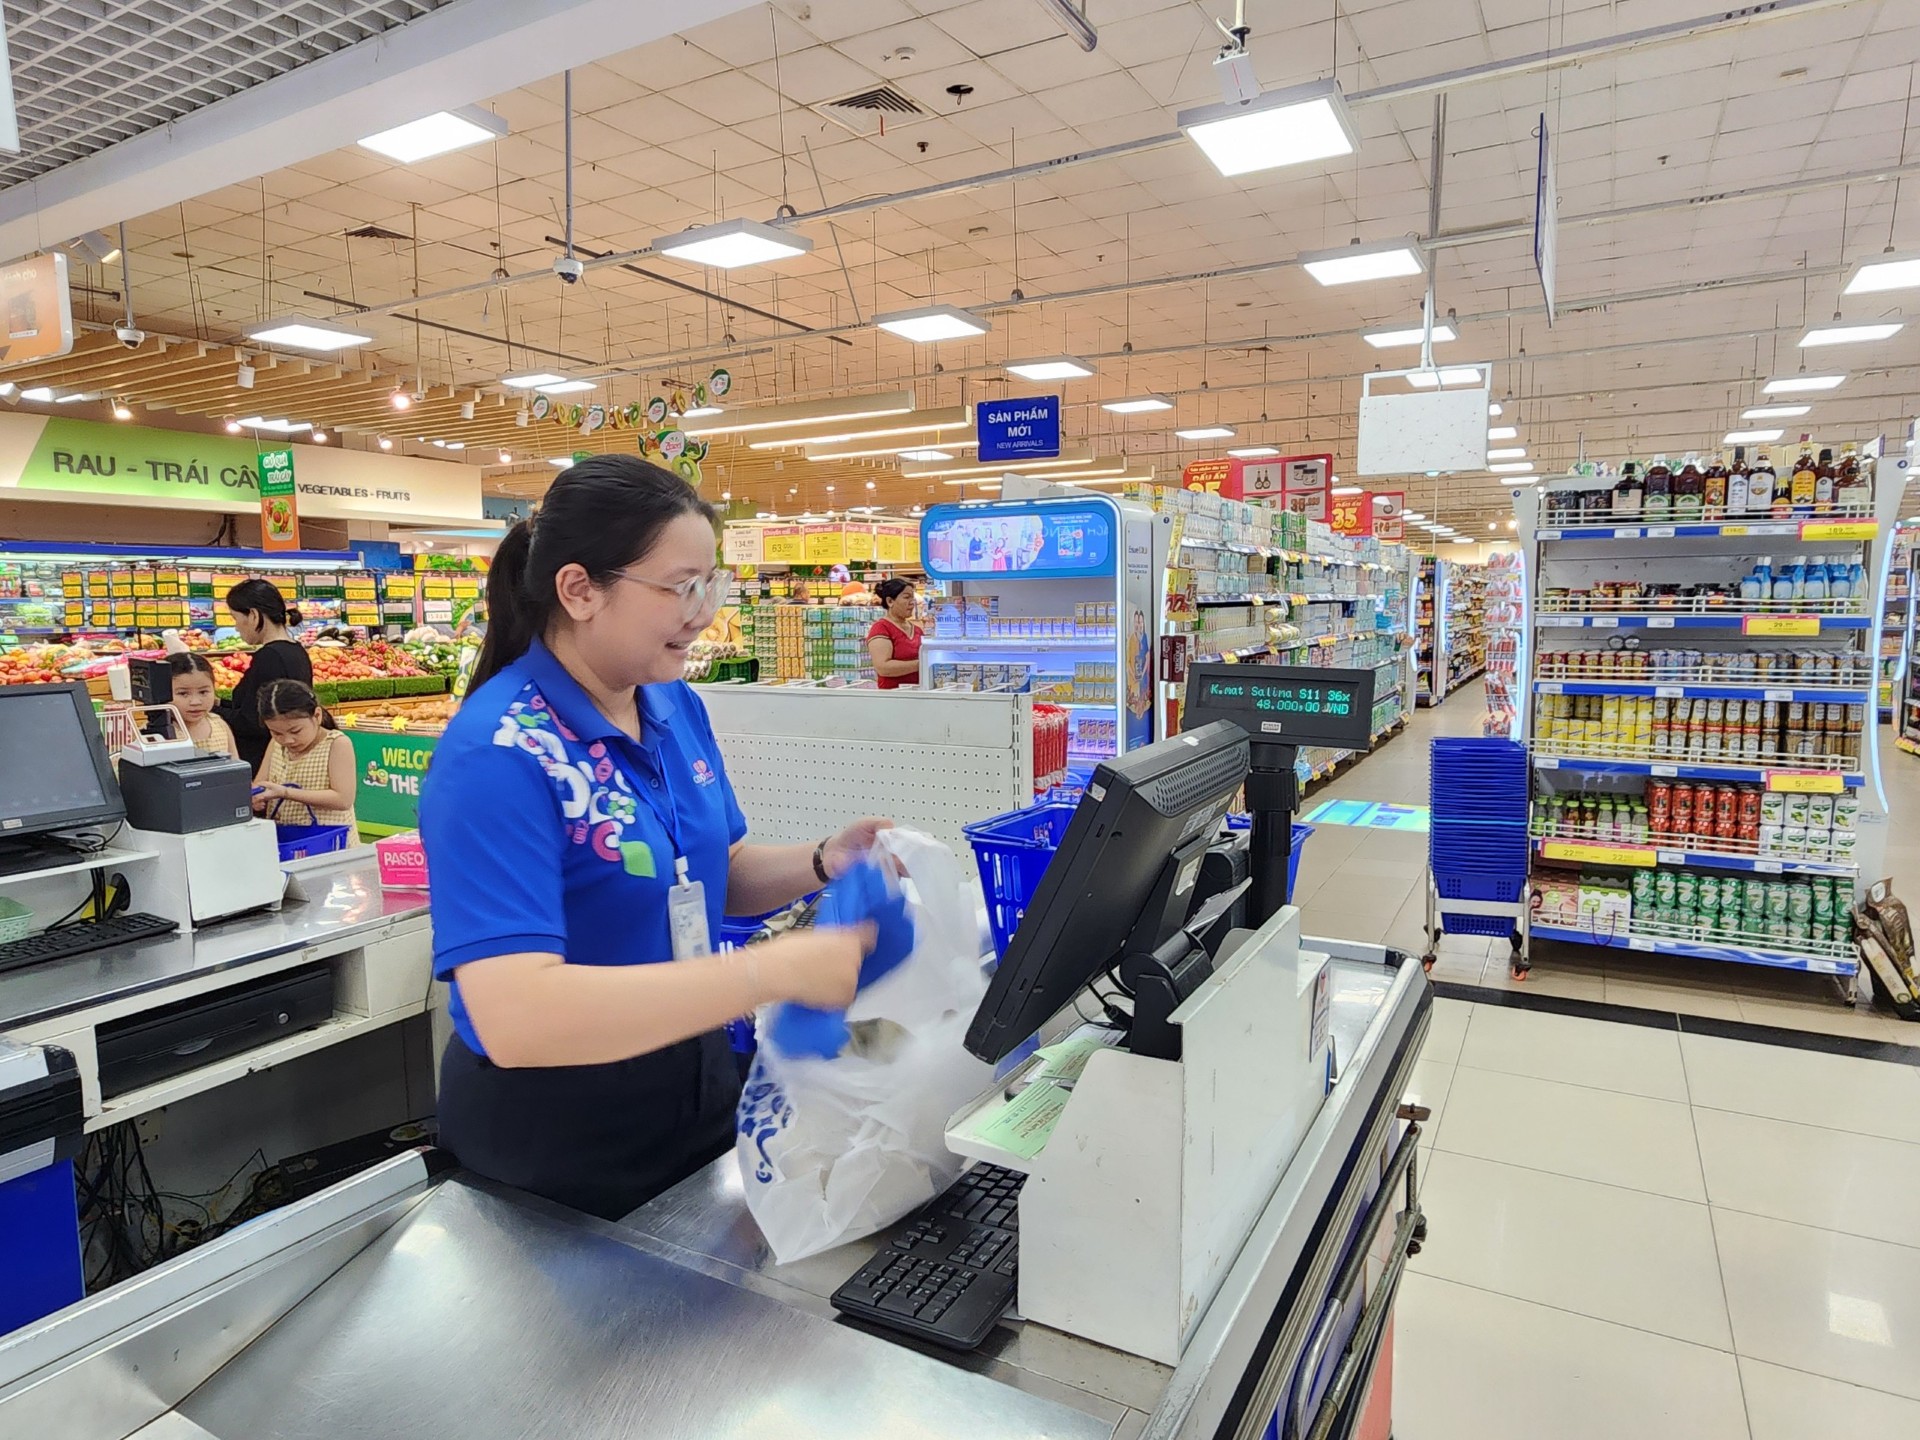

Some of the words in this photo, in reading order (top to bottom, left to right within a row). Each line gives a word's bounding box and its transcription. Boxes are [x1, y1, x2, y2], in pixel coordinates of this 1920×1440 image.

[1007, 423, 1032, 438] MỚI
[996, 441, 1012, 449] NEW
[1012, 440, 1044, 449] ARRIVALS
[53, 451, 116, 477] RAU
[145, 459, 209, 485] TRÁI
[297, 483, 369, 498] VEGETABLES
[376, 490, 411, 501] FRUITS
[1331, 507, 1357, 529] 35
[1210, 683, 1244, 696] K.mat
[1299, 688, 1320, 700] S11
[1327, 690, 1350, 702] 36x
[1256, 699, 1320, 713] 48.000,00
[1326, 703, 1349, 715] VND
[390, 773, 420, 796] THE
[383, 852, 425, 867] PASEO
